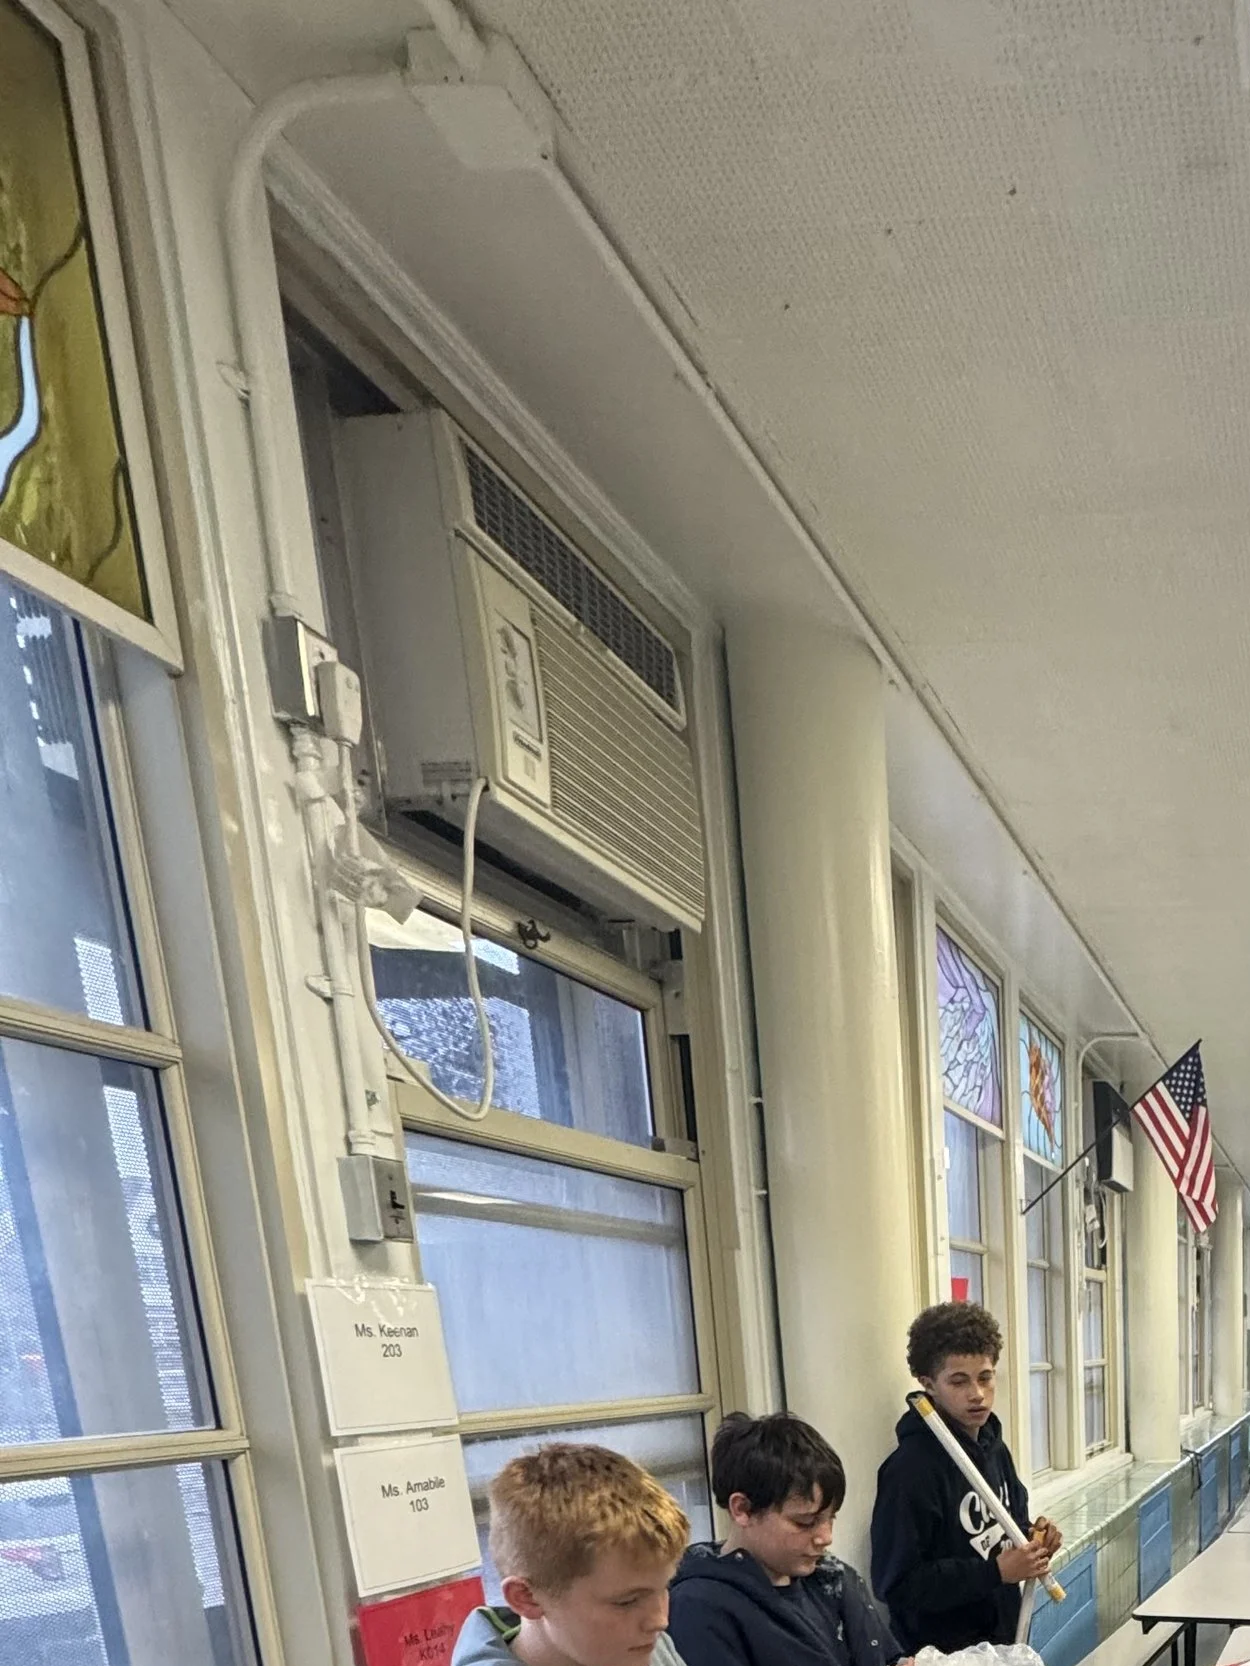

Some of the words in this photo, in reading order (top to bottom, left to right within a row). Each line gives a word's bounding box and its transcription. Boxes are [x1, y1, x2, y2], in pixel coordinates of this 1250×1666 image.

[355, 1323, 377, 1338] Ms.
[378, 1323, 419, 1338] Keenan
[381, 1343, 403, 1358] 203
[381, 1483, 403, 1498] Ms.
[406, 1476, 446, 1495] Amabile
[409, 1497, 429, 1512] 103
